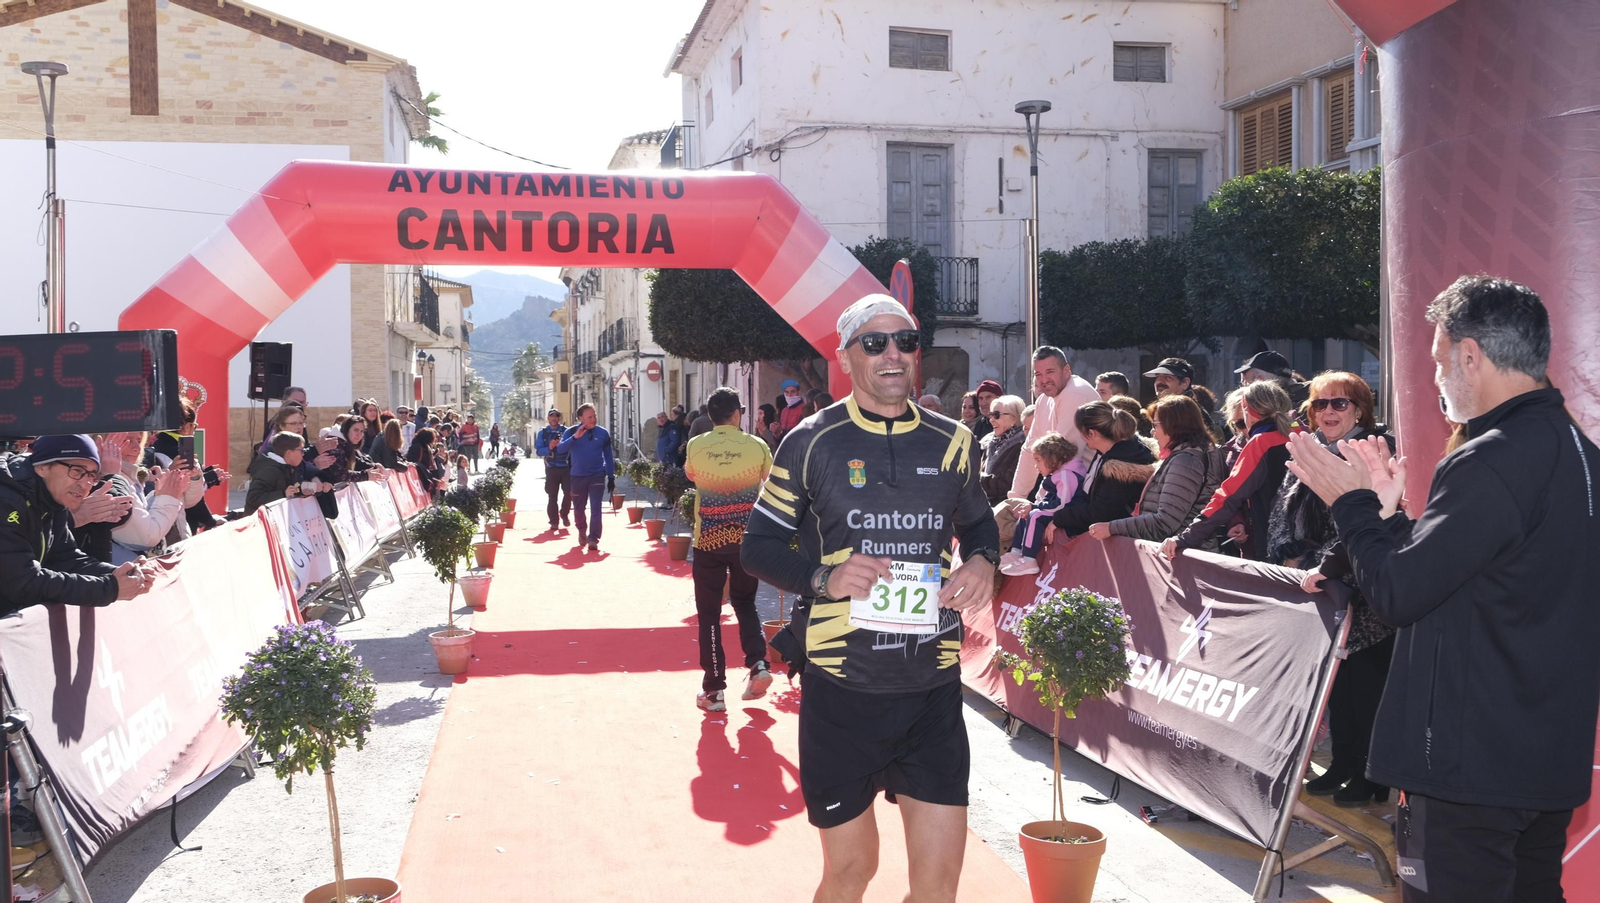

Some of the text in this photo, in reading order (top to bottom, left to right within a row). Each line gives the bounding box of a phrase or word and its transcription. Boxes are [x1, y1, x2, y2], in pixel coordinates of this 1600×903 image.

[387, 169, 685, 200] AYUNTAMIENTO
[397, 206, 676, 255] CANTORIA
[846, 507, 944, 530] Cantoria
[861, 539, 932, 555] Runners
[889, 562, 905, 571] xM
[872, 584, 928, 614] 312
